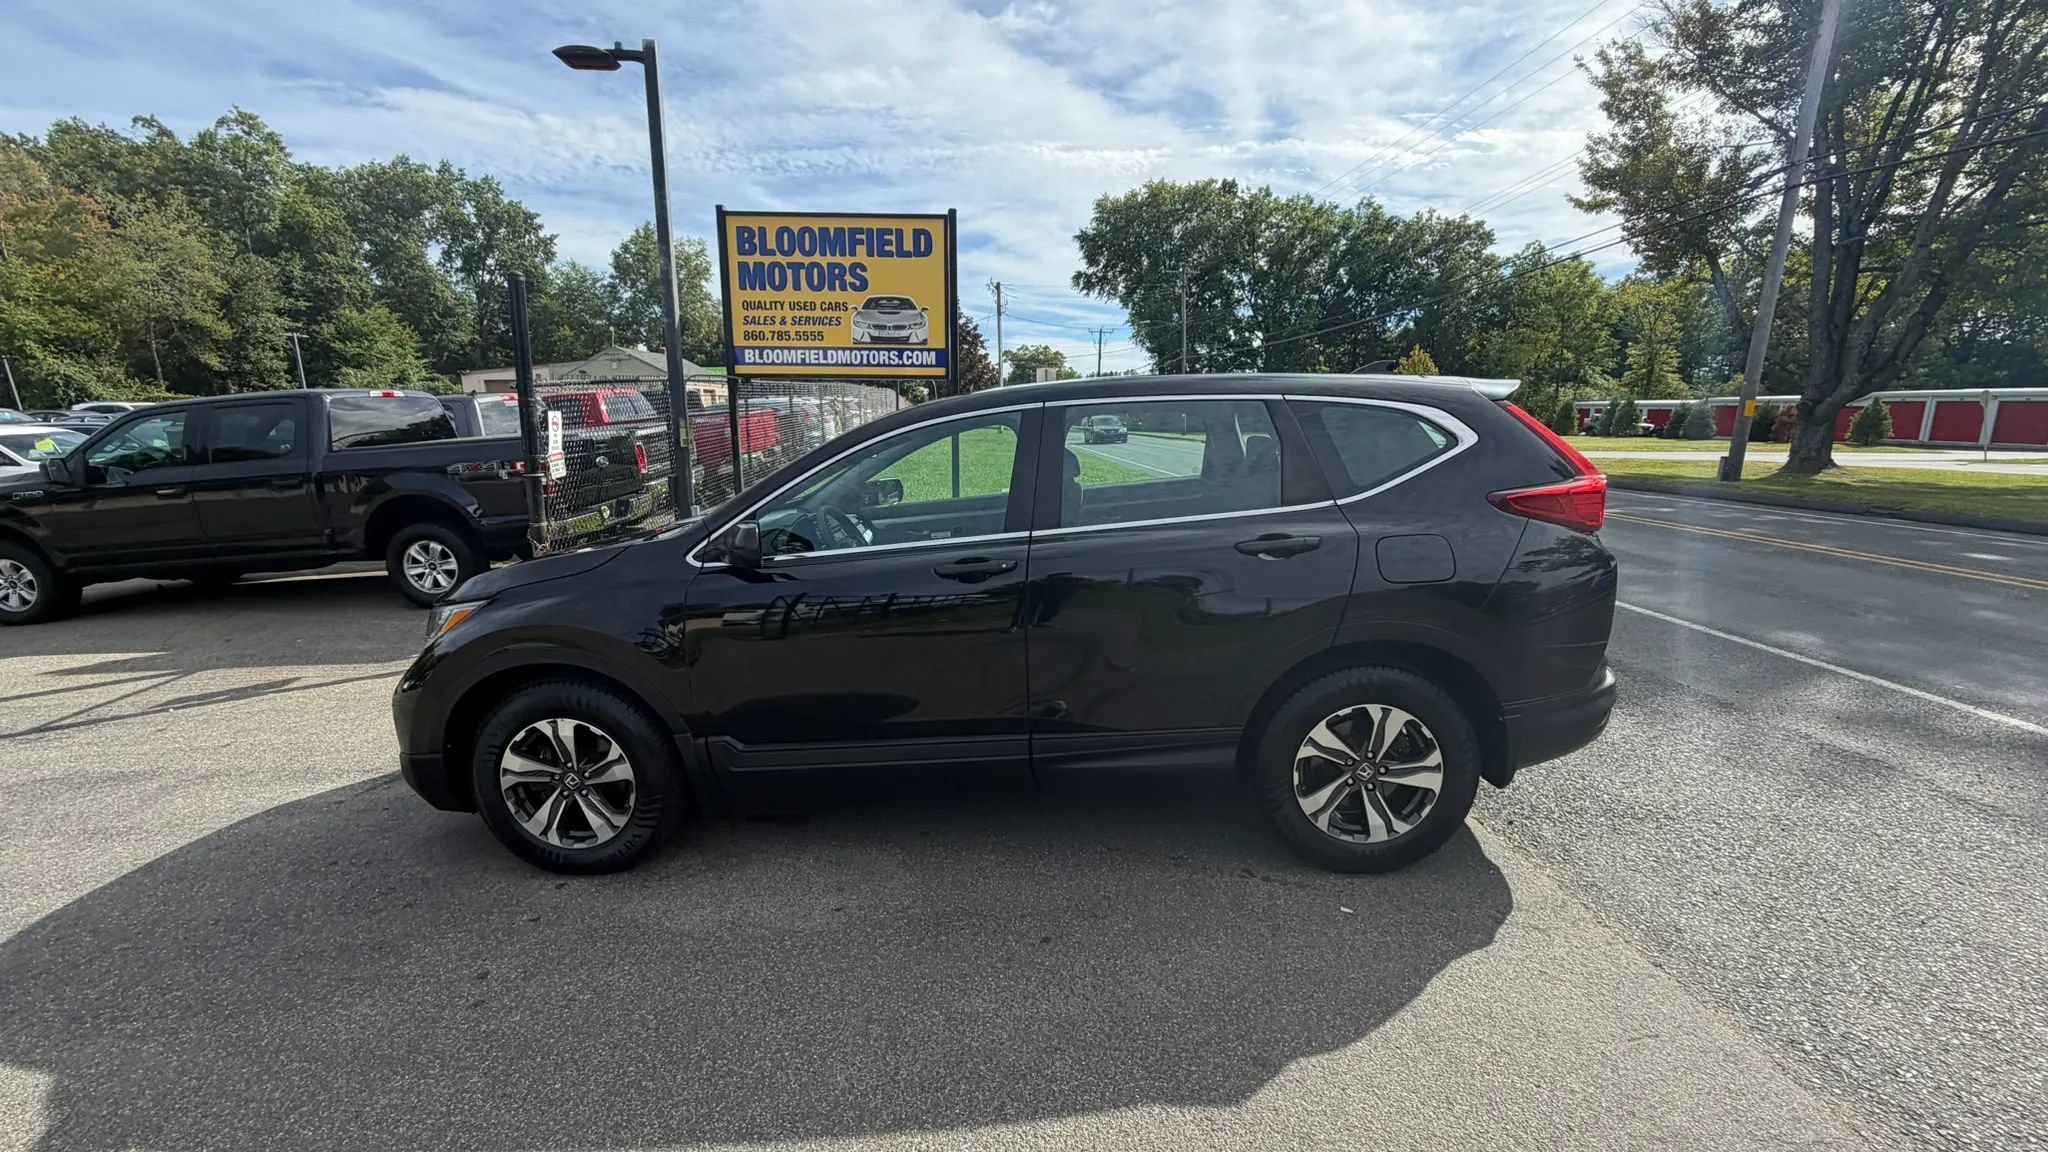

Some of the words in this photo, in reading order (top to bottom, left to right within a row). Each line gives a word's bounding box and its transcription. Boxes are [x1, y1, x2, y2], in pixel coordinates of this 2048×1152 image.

[736, 226, 933, 258] BLOOMFIELD
[738, 262, 869, 292] MOTORS
[742, 300, 785, 311] QUALITY
[789, 301, 816, 311] USED
[820, 302, 848, 312] CARS
[743, 316, 776, 326] SALES
[779, 316, 787, 326] &
[791, 317, 842, 327] SERVICES
[743, 330, 824, 341] 860.785.5555
[744, 349, 936, 365] BLOOMFIELDMOTORS.COM
